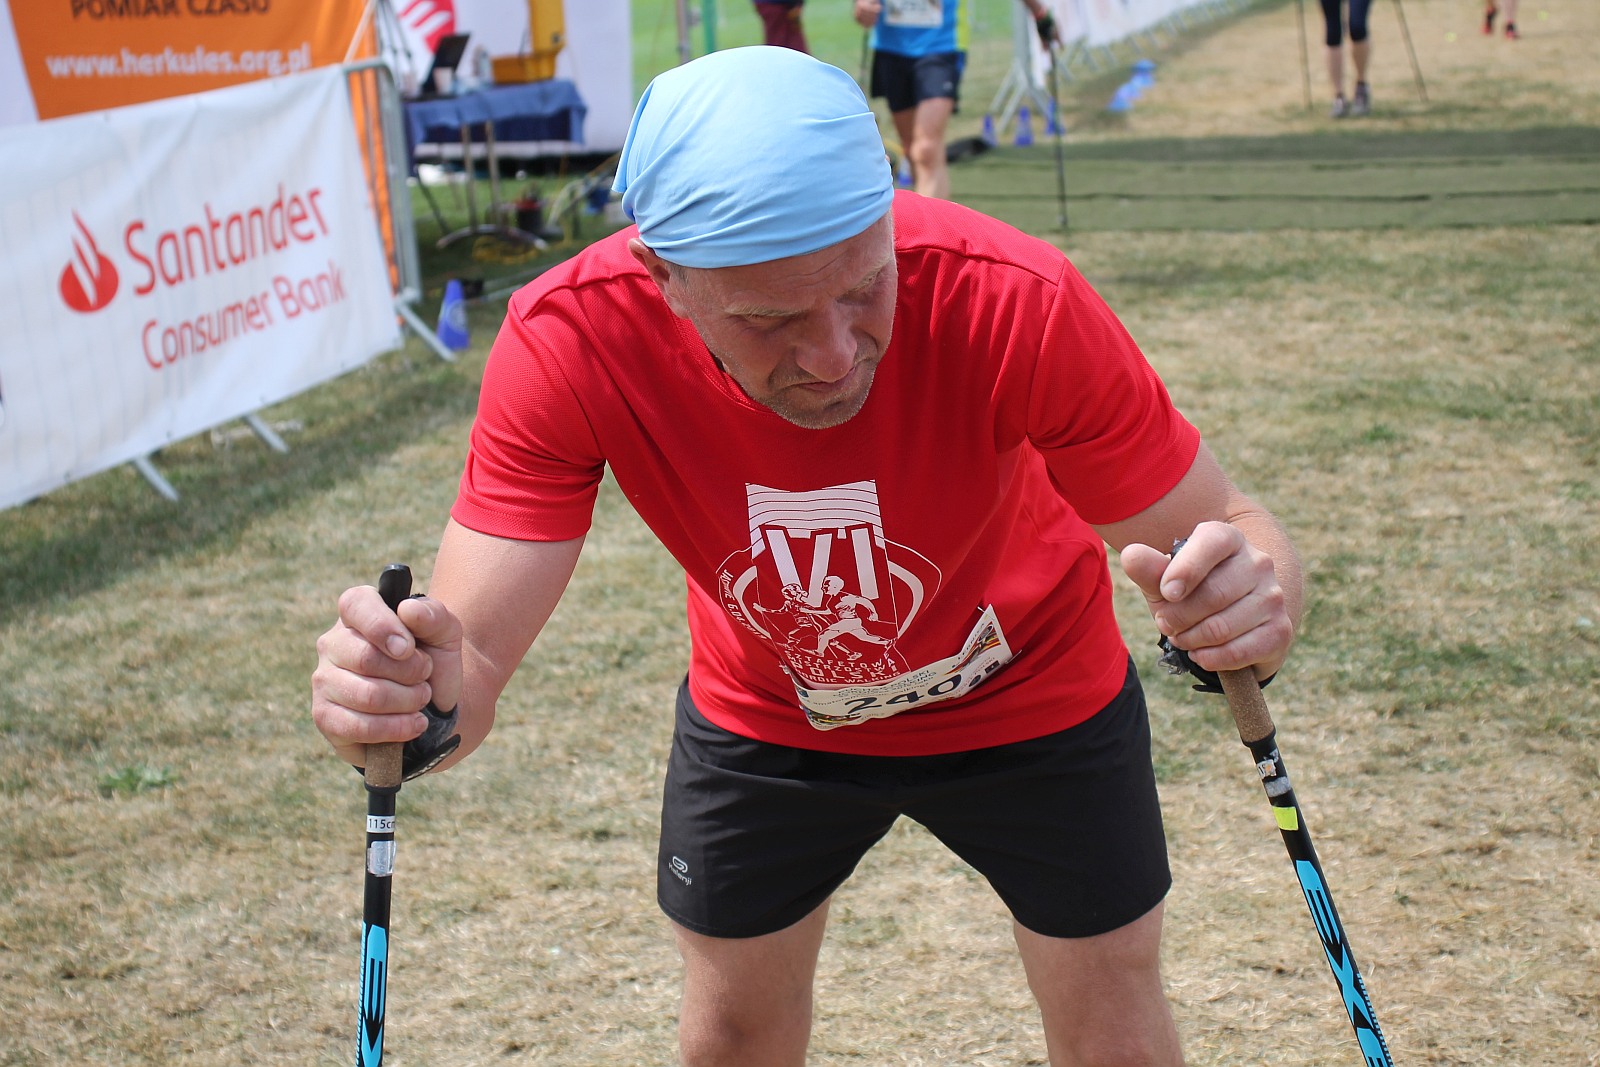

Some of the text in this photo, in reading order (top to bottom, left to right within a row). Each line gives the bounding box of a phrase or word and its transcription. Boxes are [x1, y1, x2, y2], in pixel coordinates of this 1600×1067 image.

[46, 42, 311, 79] www.herkules.org.pl
[124, 181, 329, 297] Santander
[142, 260, 348, 370] Consumer Bank
[792, 661, 898, 680] POLSKI
[844, 672, 901, 684] WALKING
[844, 673, 962, 714] 240
